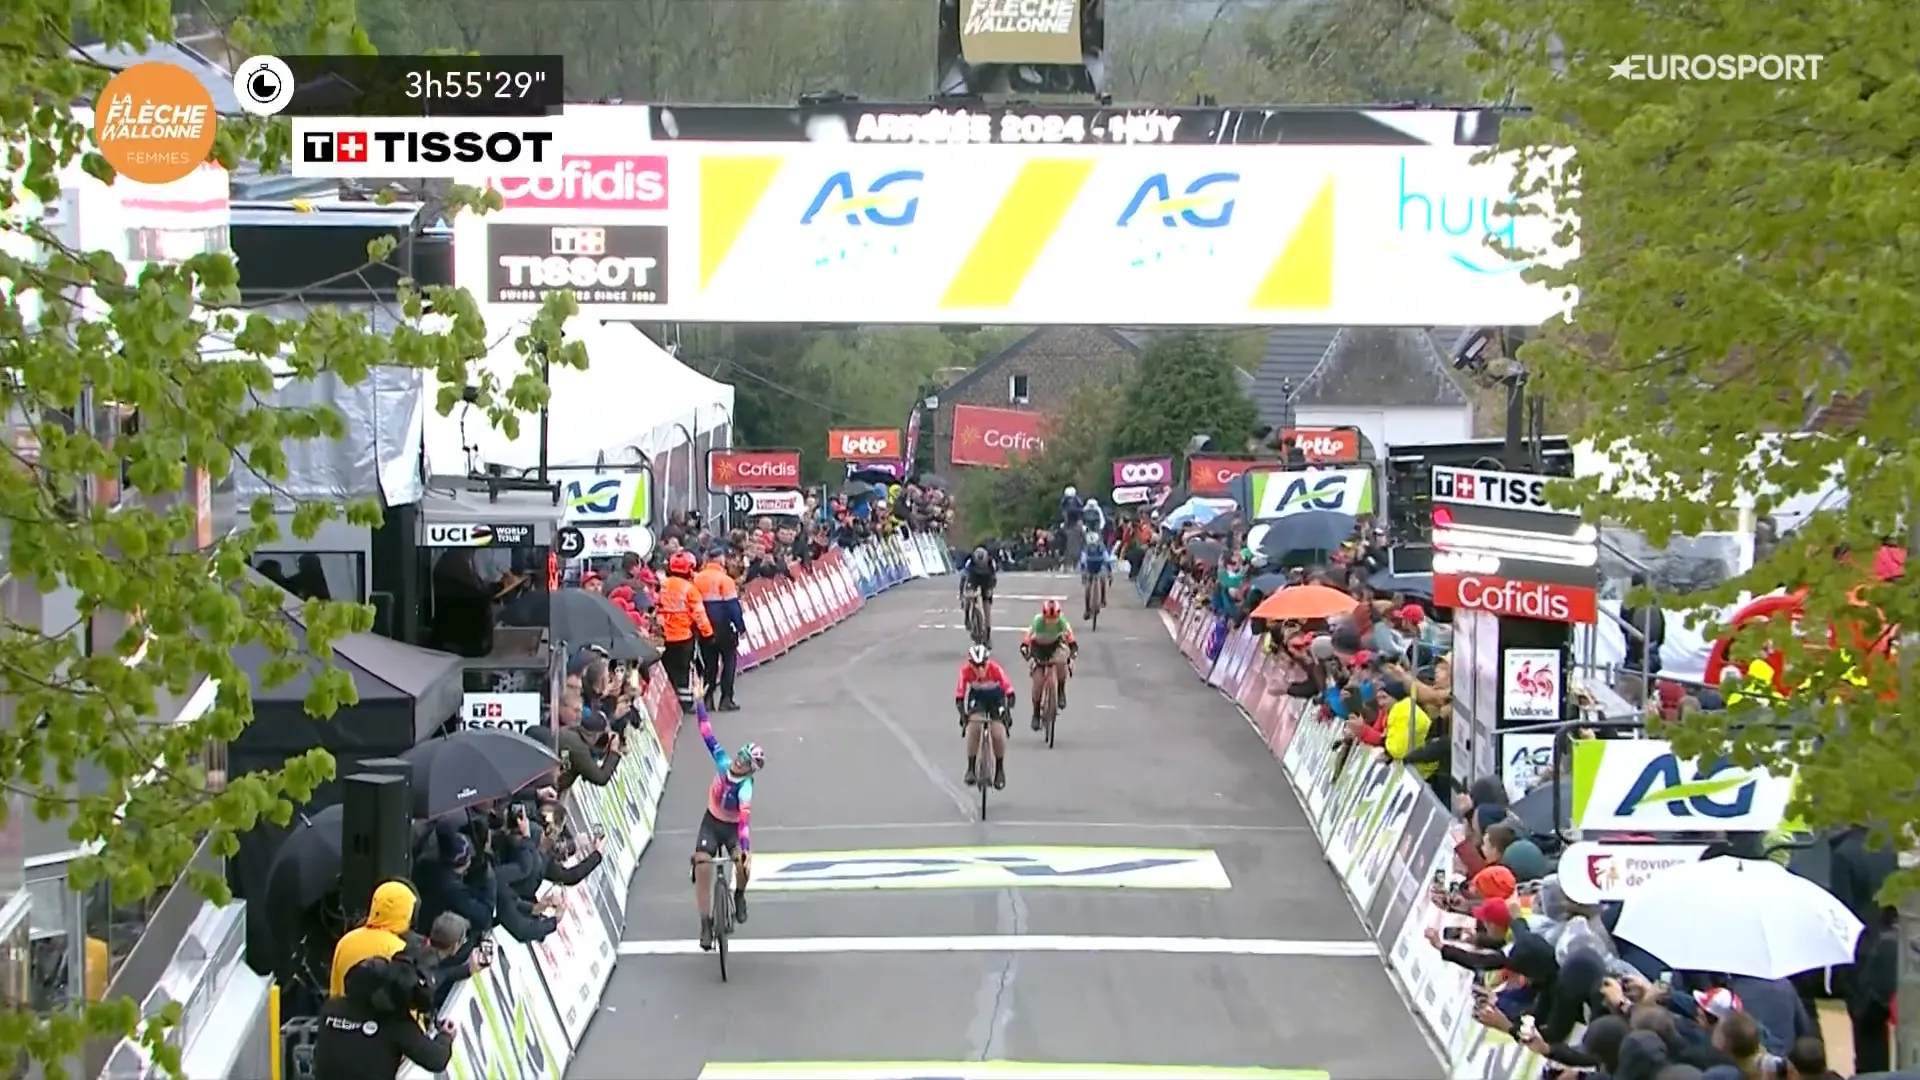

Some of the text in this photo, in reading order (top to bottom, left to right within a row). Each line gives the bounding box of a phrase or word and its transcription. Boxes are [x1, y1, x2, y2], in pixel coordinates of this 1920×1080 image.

[964, 12, 1070, 36] WALLONNE
[1000, 113, 1084, 143] 2024
[1109, 110, 1182, 144] HUY
[800, 171, 925, 226] AG
[1116, 173, 1240, 228] AG
[499, 256, 657, 287] TISSOT
[842, 434, 887, 455] lotto
[1296, 434, 1344, 455] lotto
[738, 461, 796, 477] Cofidis
[1275, 475, 1348, 511] AG
[1479, 475, 1546, 507] TISS
[734, 494, 749, 511] 50
[431, 526, 528, 542] UCI WORLD
[498, 534, 522, 543] TOUR
[561, 533, 577, 550] 25
[1458, 577, 1569, 619] Cofidis
[1510, 706, 1553, 717] Wallonie
[1510, 747, 1553, 766] AG
[1614, 753, 1758, 818] AG
[1626, 873, 1644, 887] de
